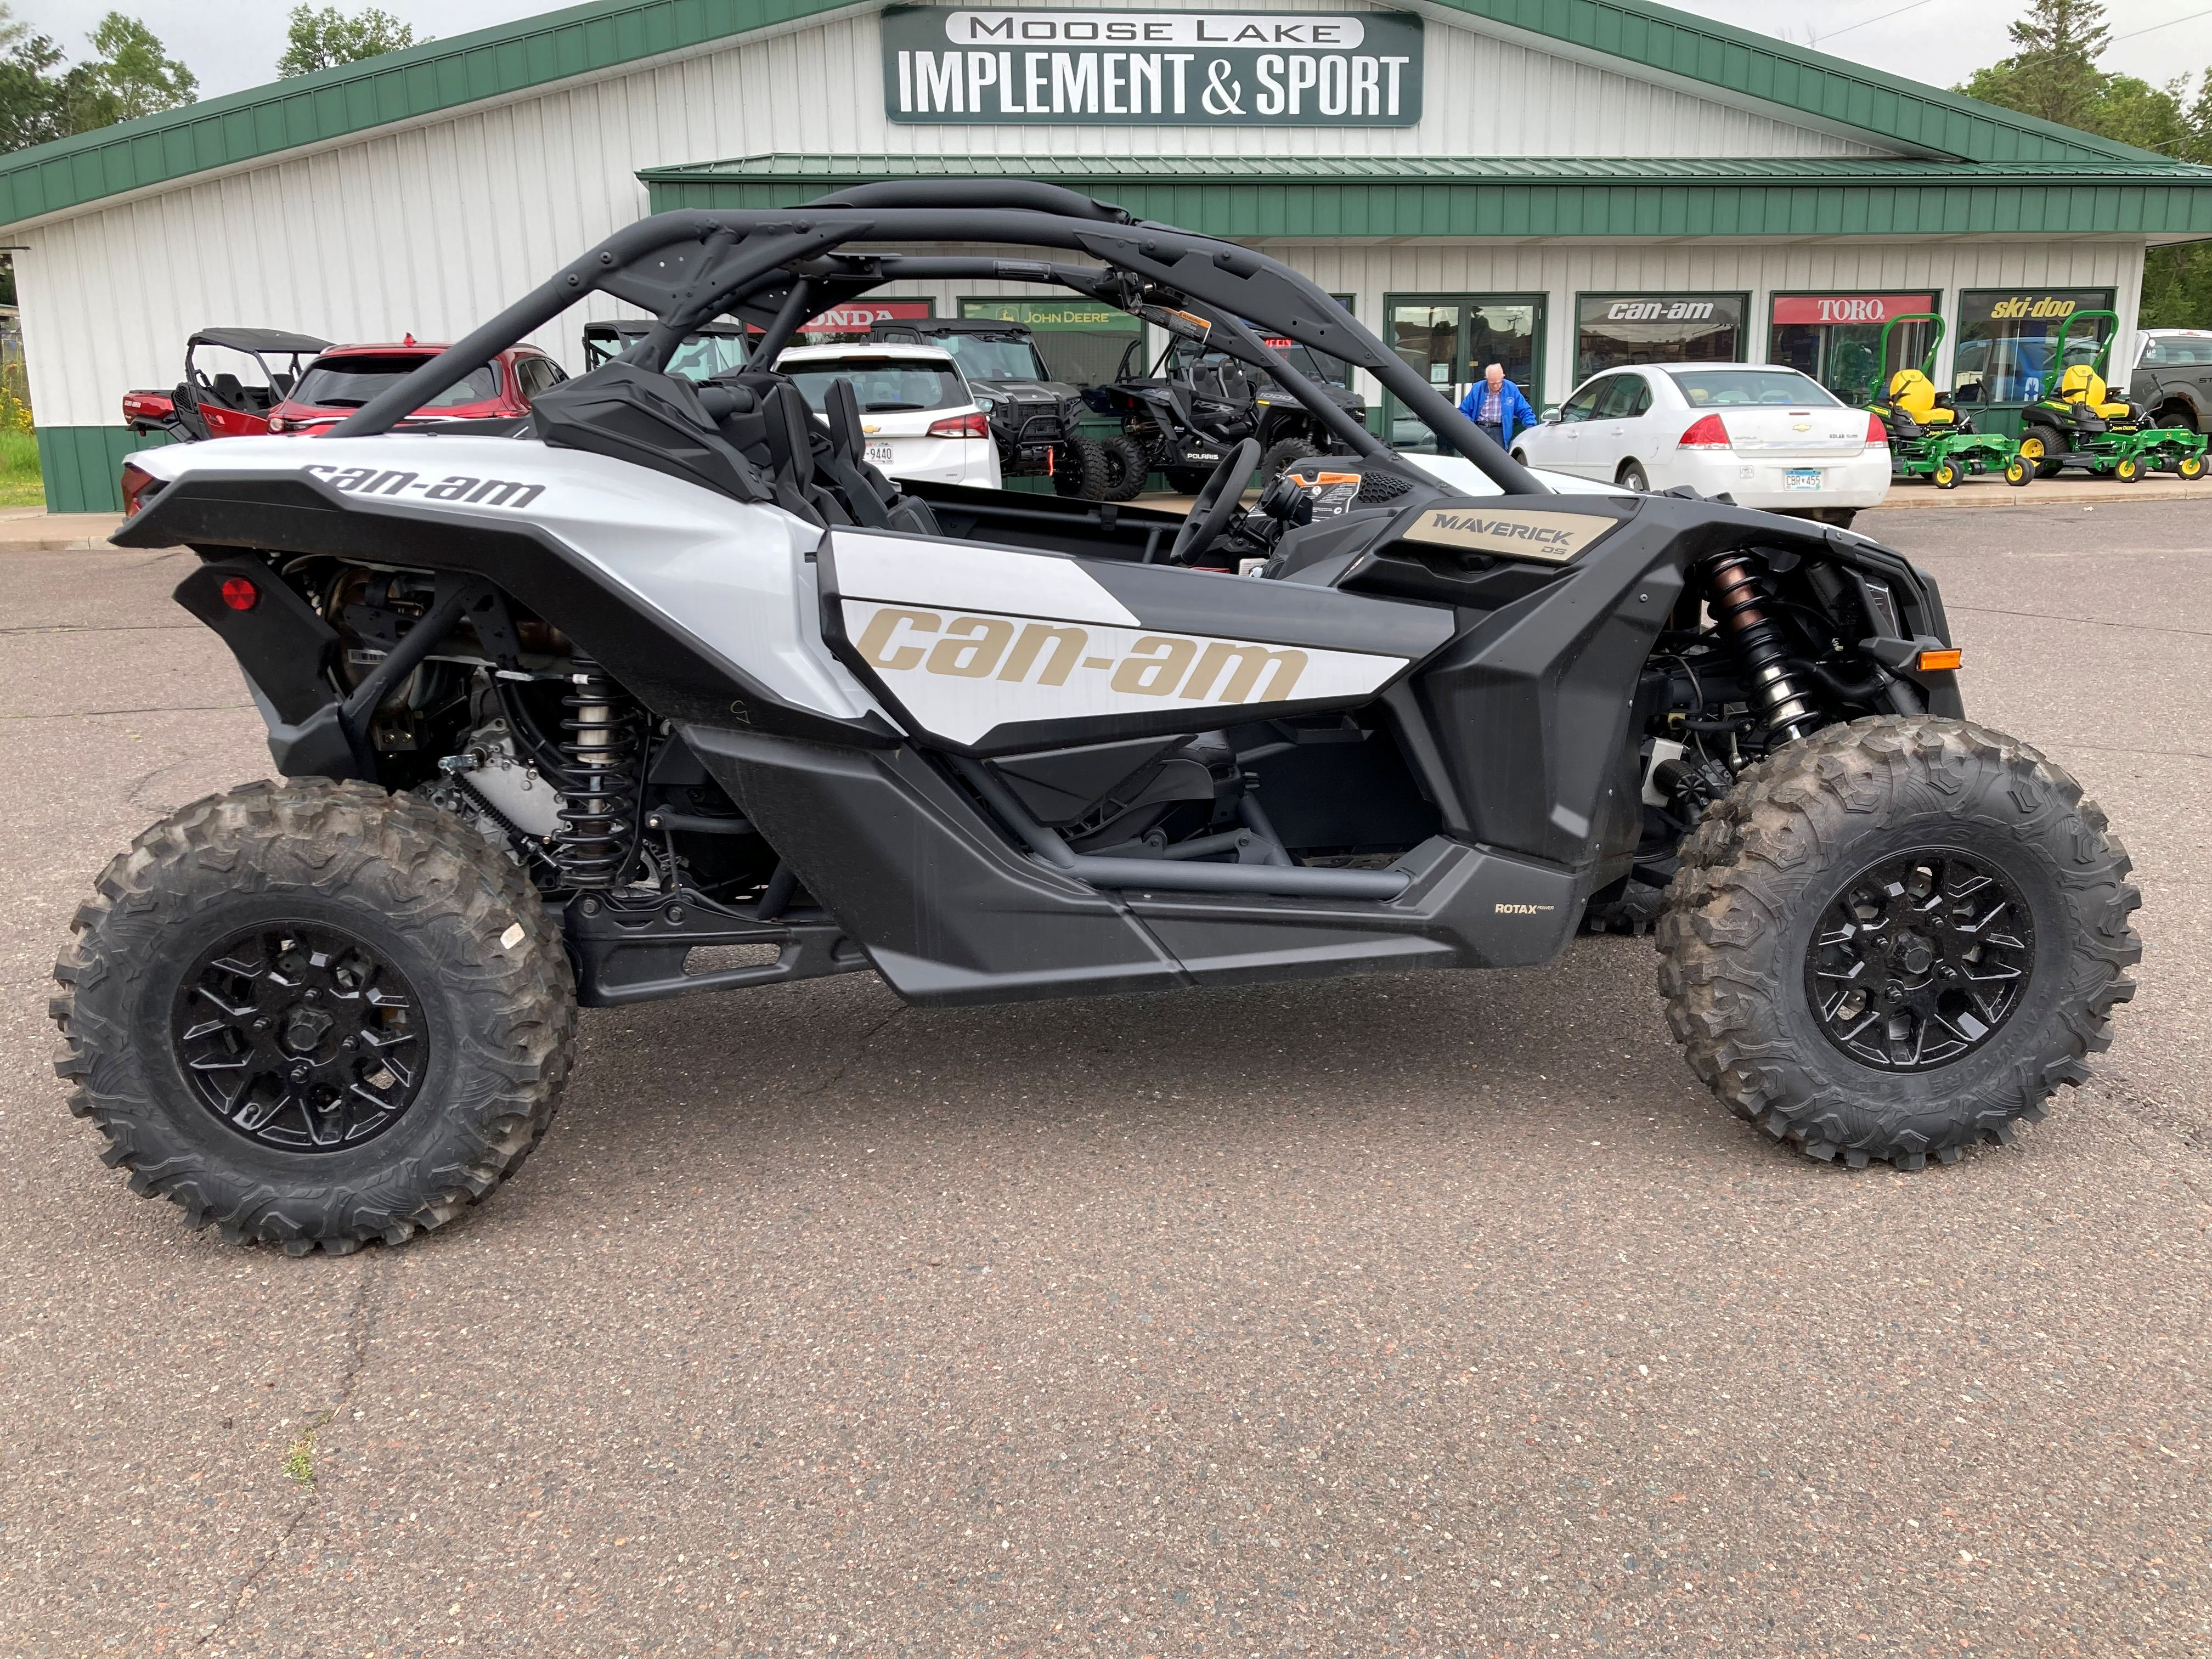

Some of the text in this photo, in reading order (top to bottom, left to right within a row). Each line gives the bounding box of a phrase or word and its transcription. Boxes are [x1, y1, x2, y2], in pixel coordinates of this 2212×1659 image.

[969, 16, 1342, 44] MOOSE LAKE
[898, 50, 1410, 116] IMPLEMENT & SPORT
[1607, 303, 1714, 319] can-am
[1991, 296, 2075, 318] ski-doo
[805, 310, 894, 326] ONDA
[1024, 311, 1109, 323] JOHN DEERE
[1432, 513, 1575, 545] MAVERICK
[1541, 546, 1567, 555] DS
[855, 608, 1309, 704] can-am
[1494, 904, 1537, 915] ROTAX
